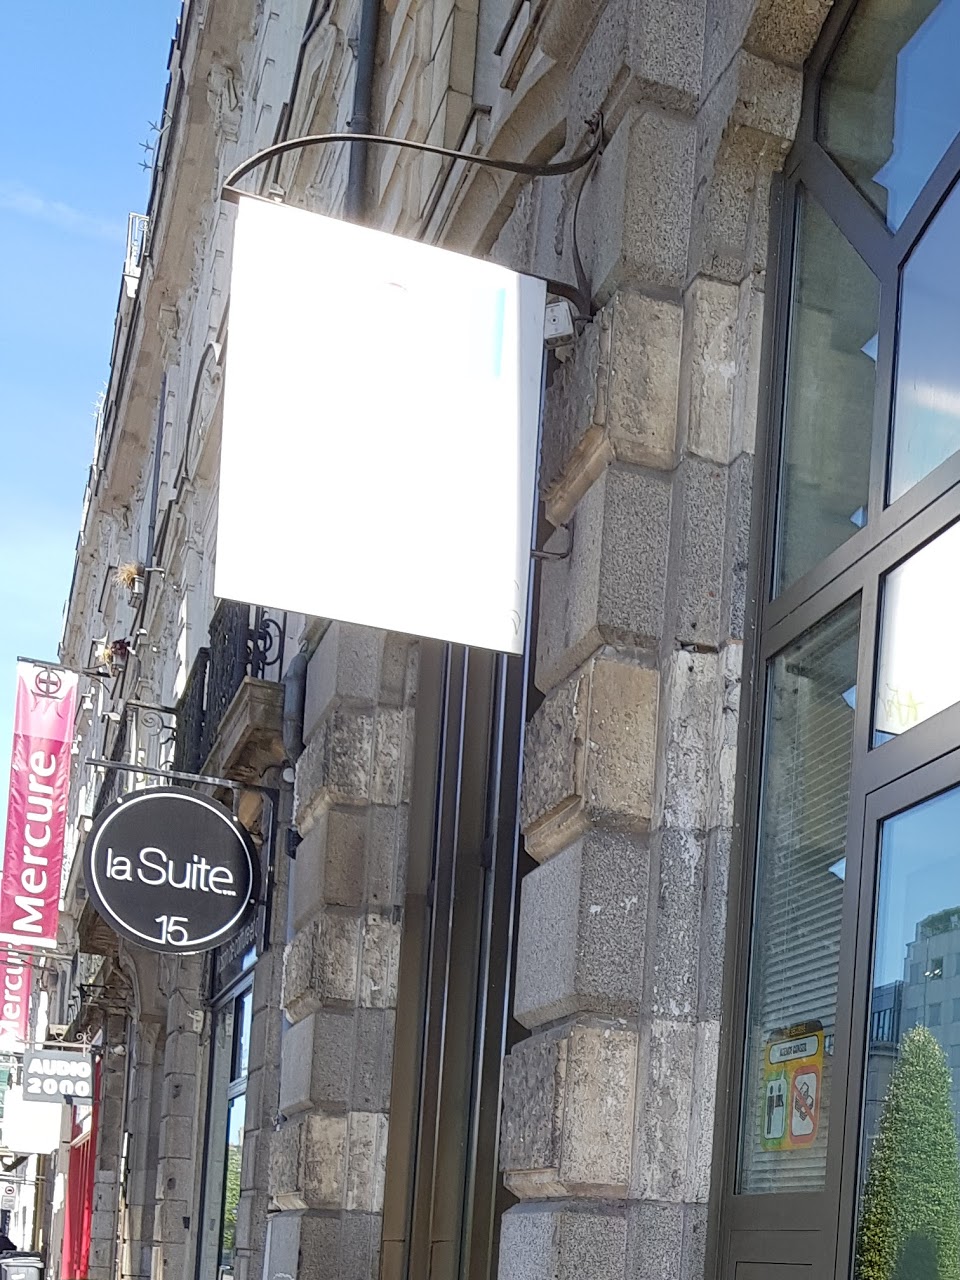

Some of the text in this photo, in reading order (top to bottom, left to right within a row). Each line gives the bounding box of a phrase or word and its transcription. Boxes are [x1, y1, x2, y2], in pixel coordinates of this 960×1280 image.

[13, 750, 56, 933] Mercure
[106, 847, 132, 881] la
[155, 915, 189, 945] 15
[28, 1058, 92, 1078] AUDIO
[27, 1077, 90, 1097] 2000
